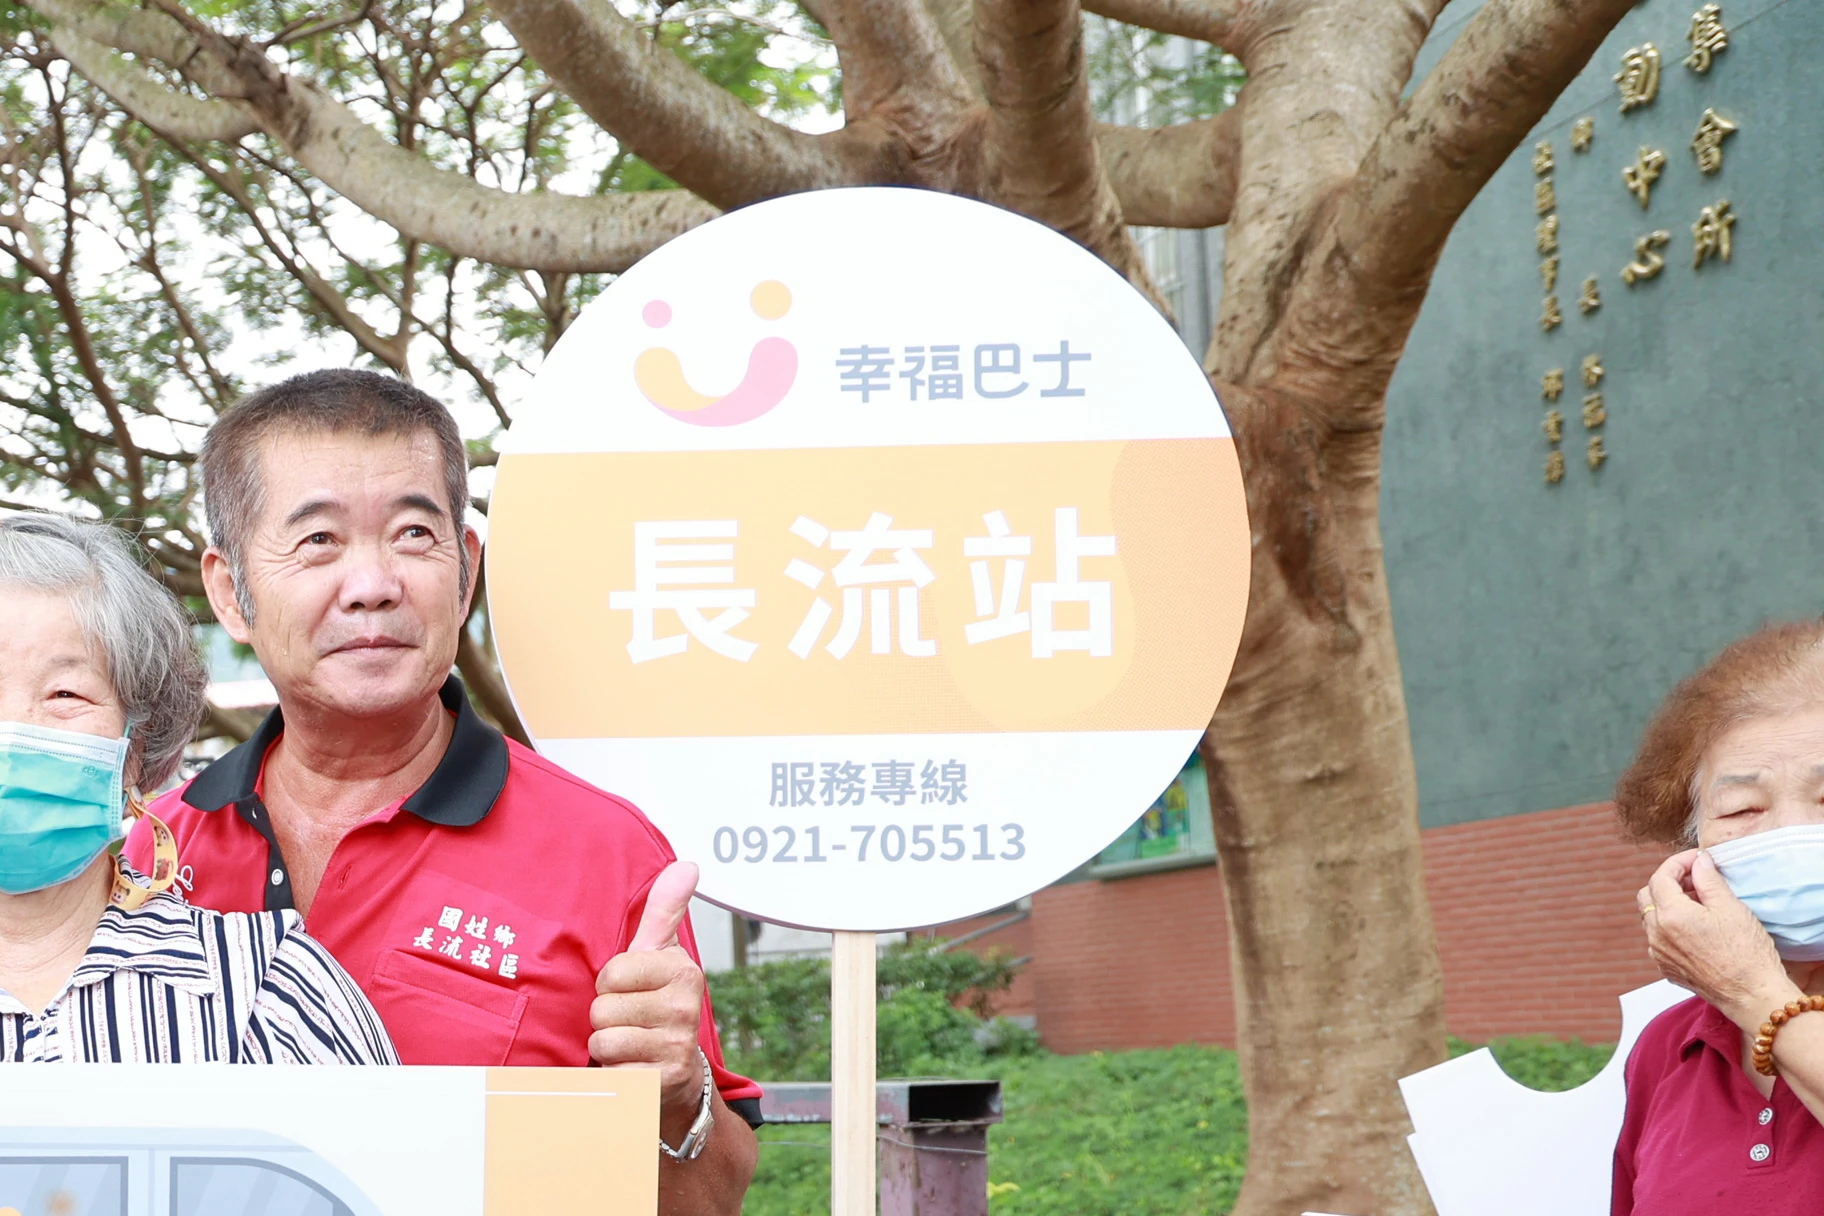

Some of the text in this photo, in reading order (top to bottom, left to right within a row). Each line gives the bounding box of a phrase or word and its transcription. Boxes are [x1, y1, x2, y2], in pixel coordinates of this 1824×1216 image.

[834, 339, 1093, 404] 幸福巴士
[608, 507, 1118, 665] 長流站
[768, 757, 969, 809] 服務專線
[711, 822, 1027, 864] 0921-705513
[412, 926, 520, 980] 長流社區
[438, 905, 517, 949] 國姓鄉
